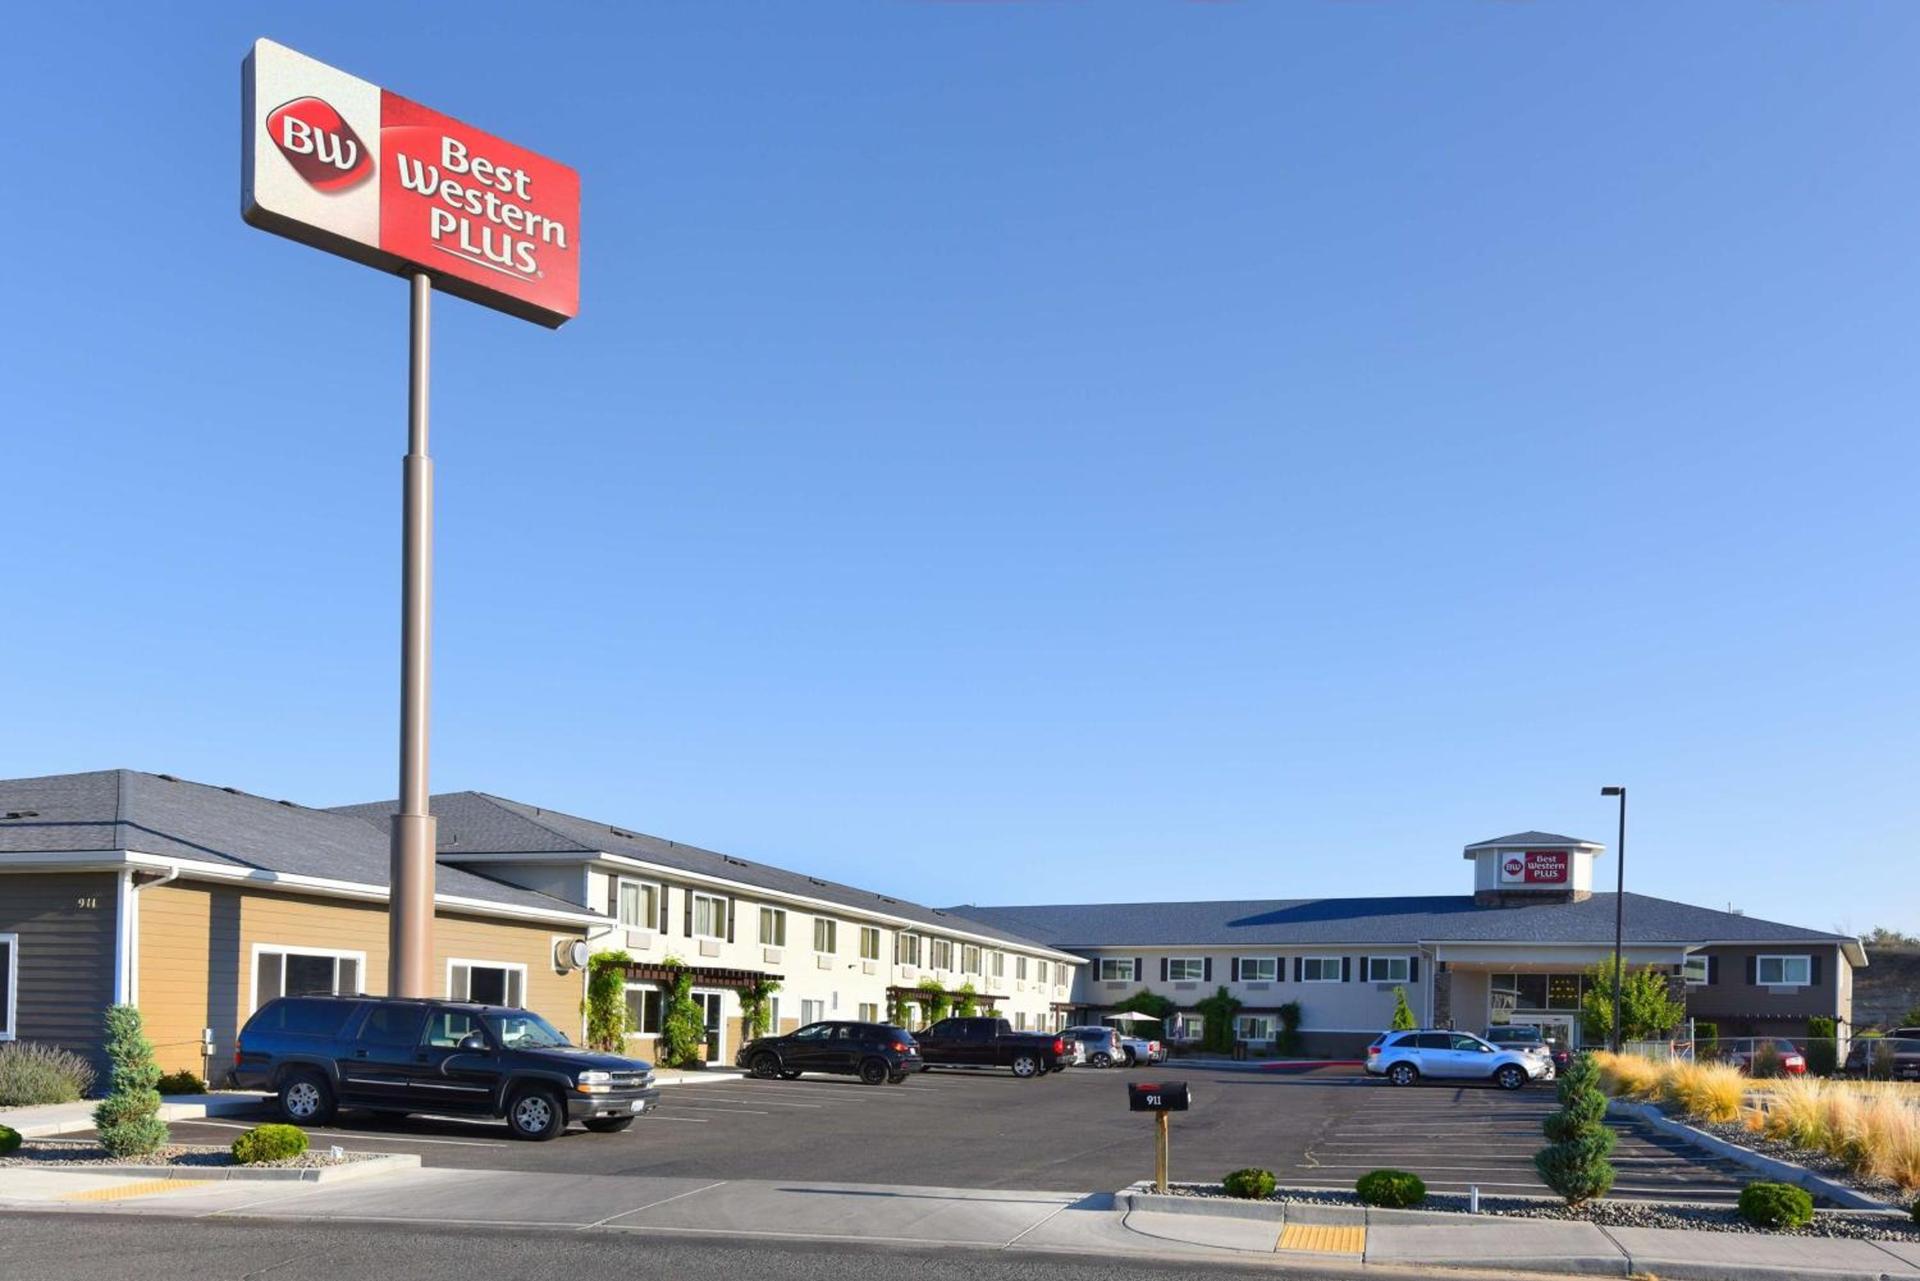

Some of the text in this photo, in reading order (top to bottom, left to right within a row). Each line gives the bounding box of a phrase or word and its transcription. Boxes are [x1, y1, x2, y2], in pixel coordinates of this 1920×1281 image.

[282, 114, 357, 170] BW
[441, 136, 532, 200] Best
[397, 153, 567, 248] Western
[430, 207, 538, 274] PLUS
[1536, 855, 1557, 863] Best
[1528, 862, 1565, 870] Western
[1534, 870, 1558, 878] PLUS
[78, 897, 96, 908] 911
[1146, 1095, 1162, 1105] 911
